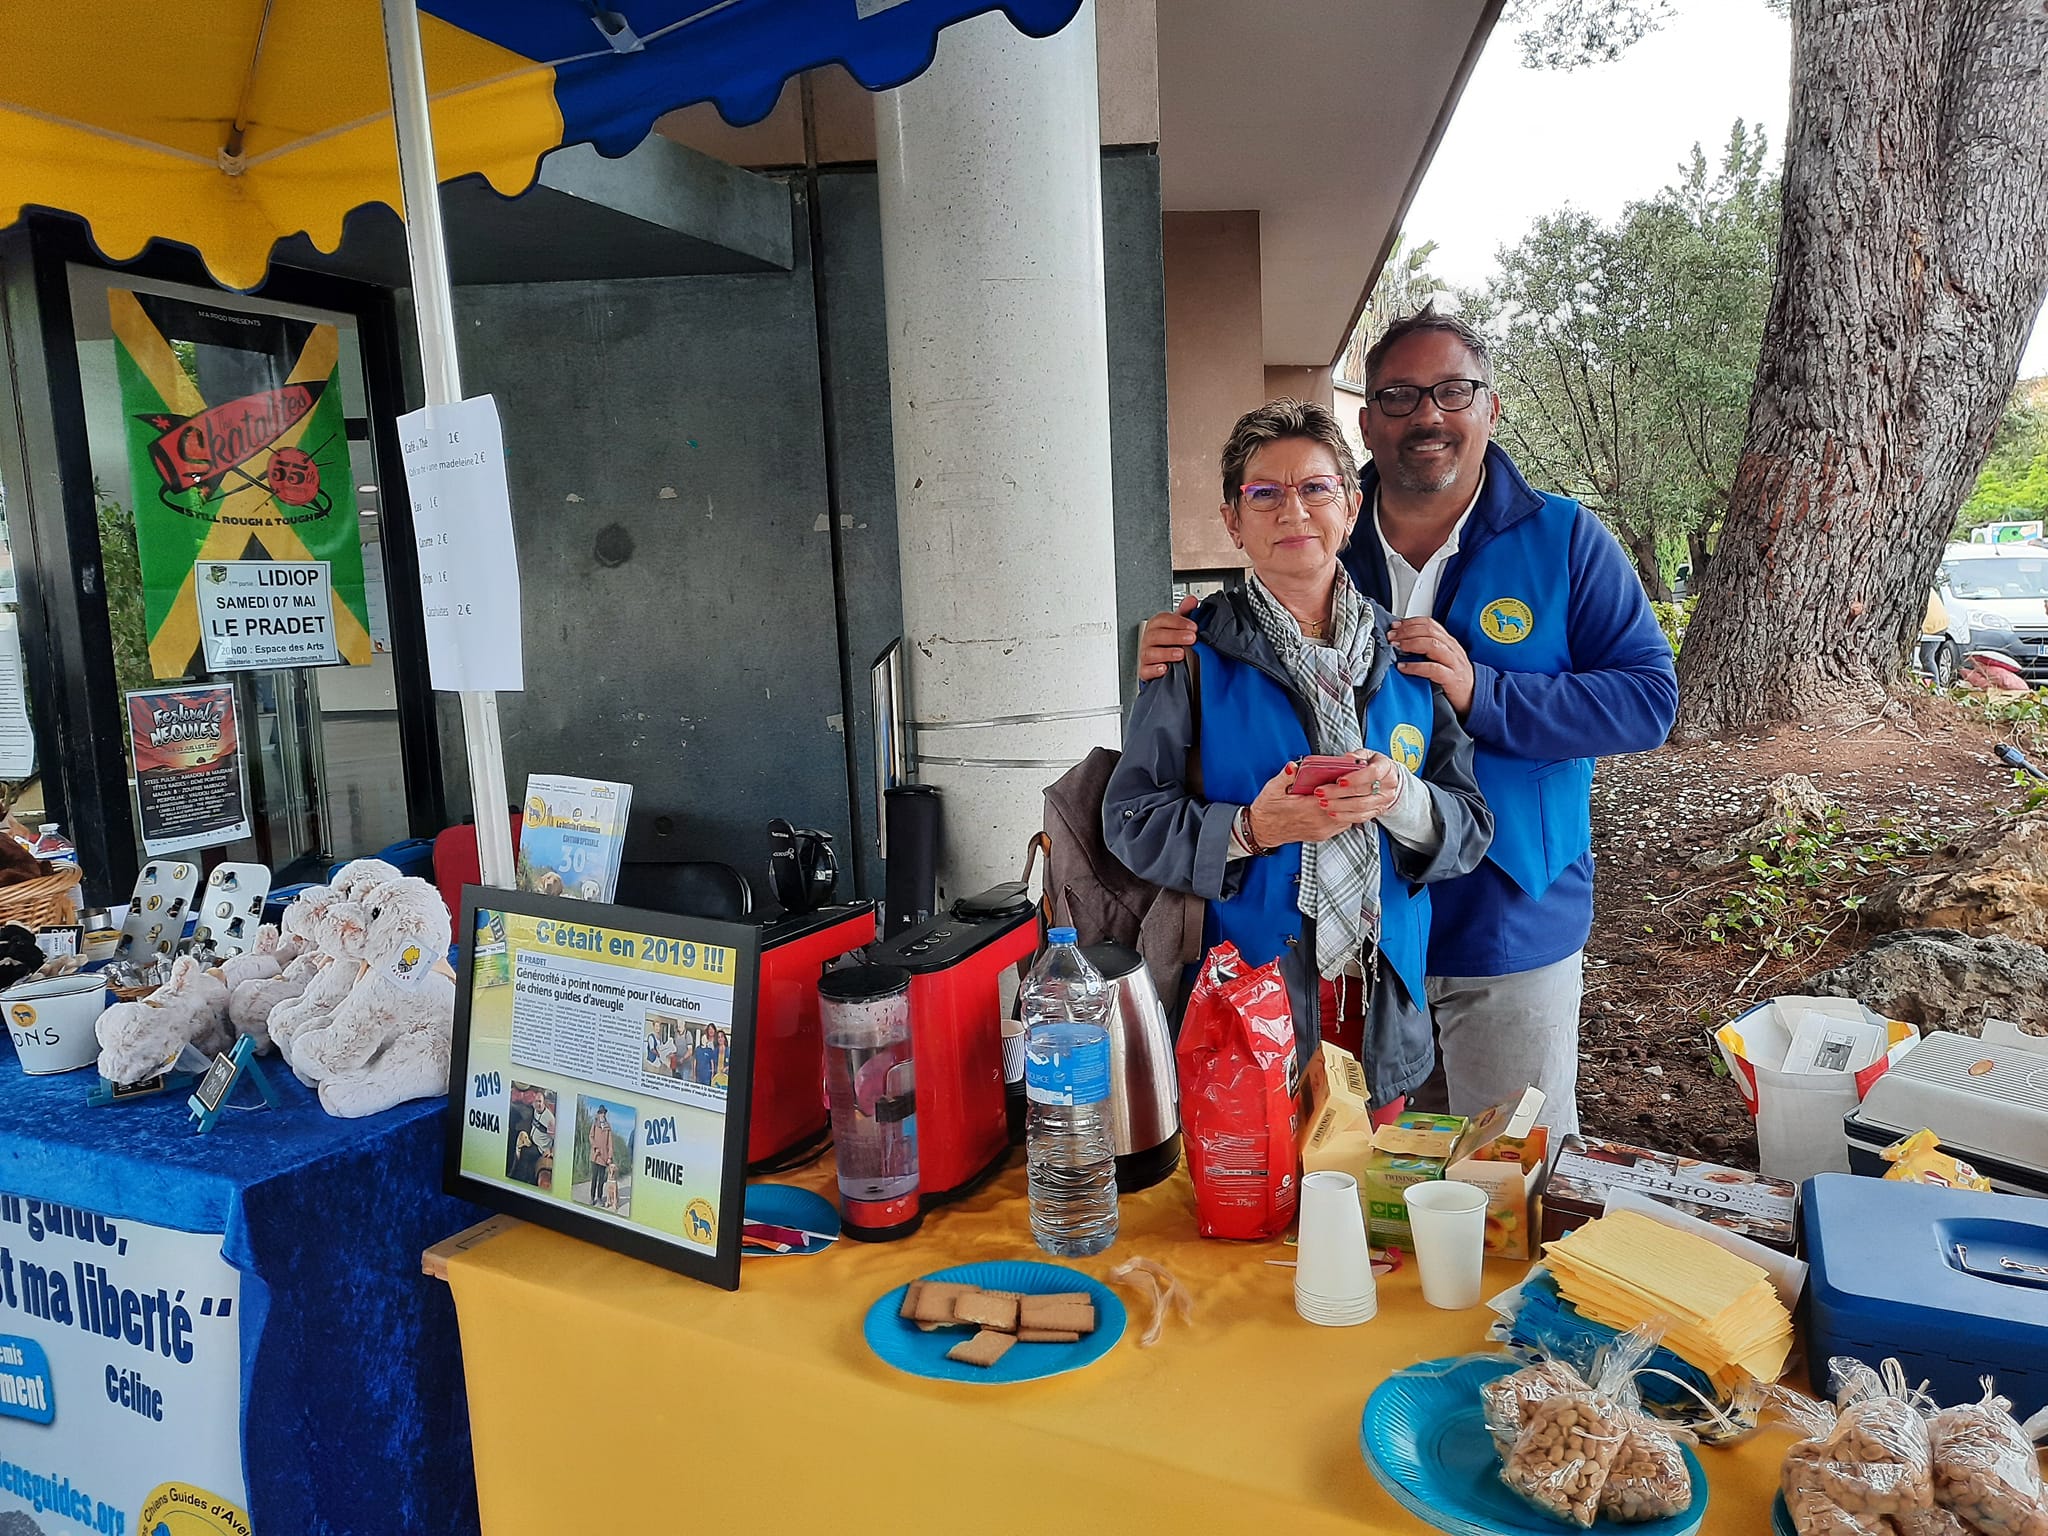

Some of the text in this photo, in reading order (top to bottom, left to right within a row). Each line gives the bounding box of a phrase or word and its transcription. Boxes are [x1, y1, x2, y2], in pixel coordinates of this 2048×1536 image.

[228, 316, 262, 327] PRESENTS
[177, 391, 308, 480] Skatalites
[404, 442, 416, 454] Café
[419, 436, 429, 449] Thé
[448, 431, 460, 444] 1€
[439, 456, 474, 471] madeleine
[186, 507, 221, 524] STILL
[221, 515, 263, 527] ROUGH
[265, 517, 273, 527] &
[257, 569, 319, 587] LIDIOP
[216, 595, 316, 609] SAMEDI 07 MAI
[212, 616, 326, 637] LE PRADET
[221, 646, 247, 656] 20h00
[255, 644, 287, 655] Espace
[288, 643, 305, 652] des
[306, 642, 325, 651] Arts
[153, 702, 212, 727] Festival
[181, 771, 205, 780] AMADOU
[558, 846, 587, 873] 30
[536, 920, 724, 973] C'était en 2019 !!!
[517, 954, 547, 967] LE PRADET
[515, 980, 624, 1012] de chiens guides d'aveugle
[516, 967, 701, 1012] Générosité à point nommé pour l'éducation
[474, 1071, 501, 1098] 2019
[468, 1109, 500, 1134] OSAKA
[644, 1116, 678, 1146] 2021
[1313, 1112, 1332, 1142] TWININGS
[644, 1156, 684, 1186] PIMKIE
[1384, 1173, 1421, 1183] TWININGS
[1615, 1170, 1731, 1204] COFFEE
[19, 1260, 74, 1326] ma
[73, 1261, 194, 1364] liberté
[104, 1364, 163, 1422] Céline
[0, 1459, 125, 1536] ensguides.org
[144, 1493, 169, 1523] Chiens
[169, 1487, 208, 1511] Guides
